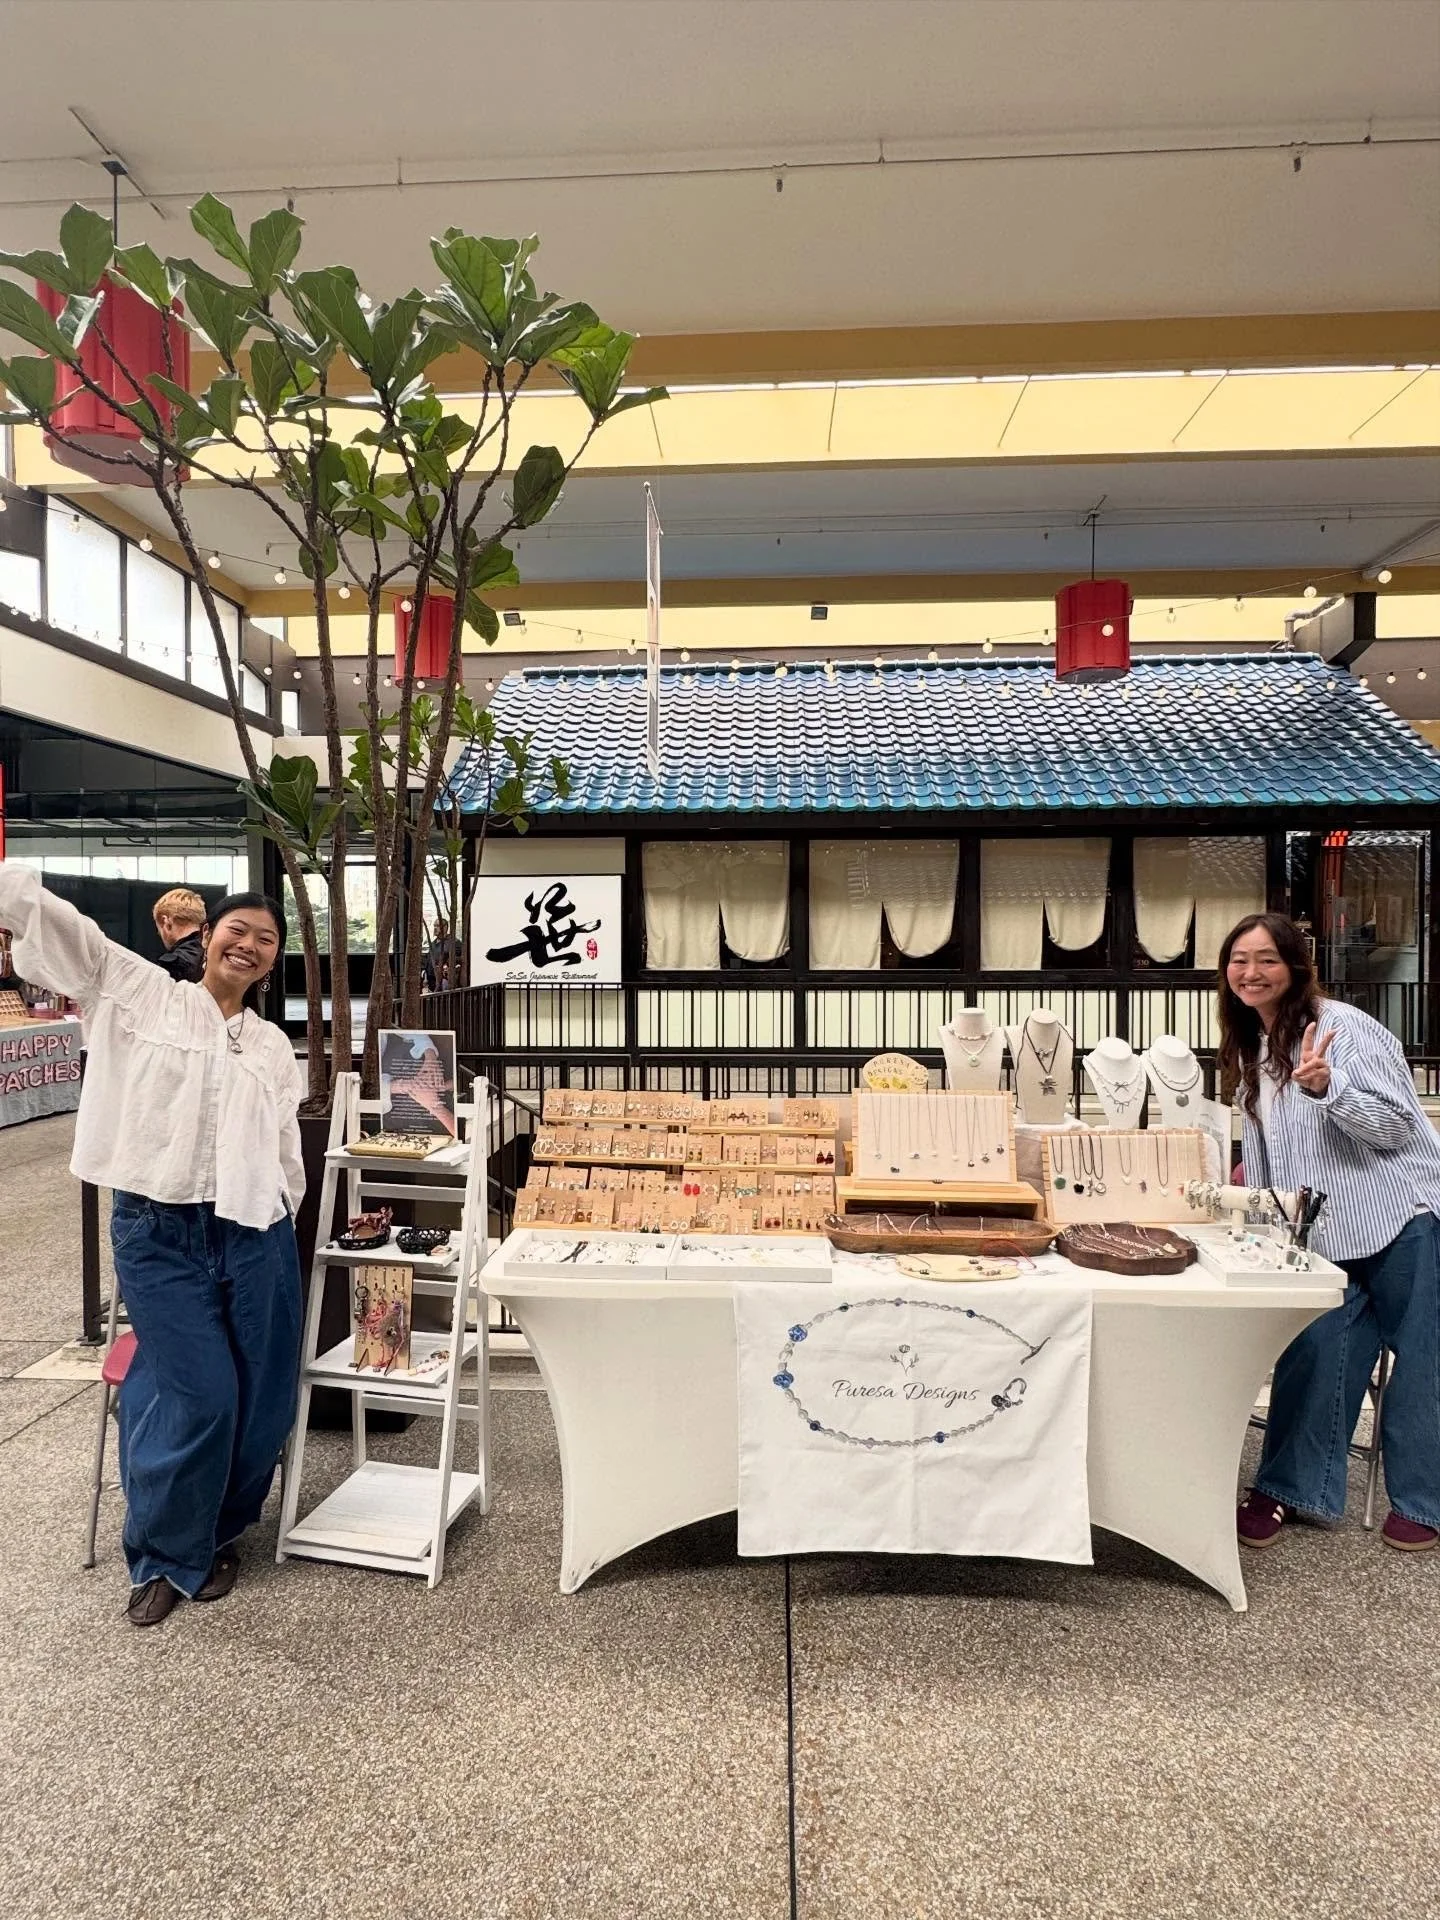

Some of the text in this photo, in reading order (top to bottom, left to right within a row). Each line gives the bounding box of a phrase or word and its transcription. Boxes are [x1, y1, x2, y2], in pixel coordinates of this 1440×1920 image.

[1, 1034, 73, 1063] HAPPY
[832, 1379, 980, 1408] Puresa Designs
